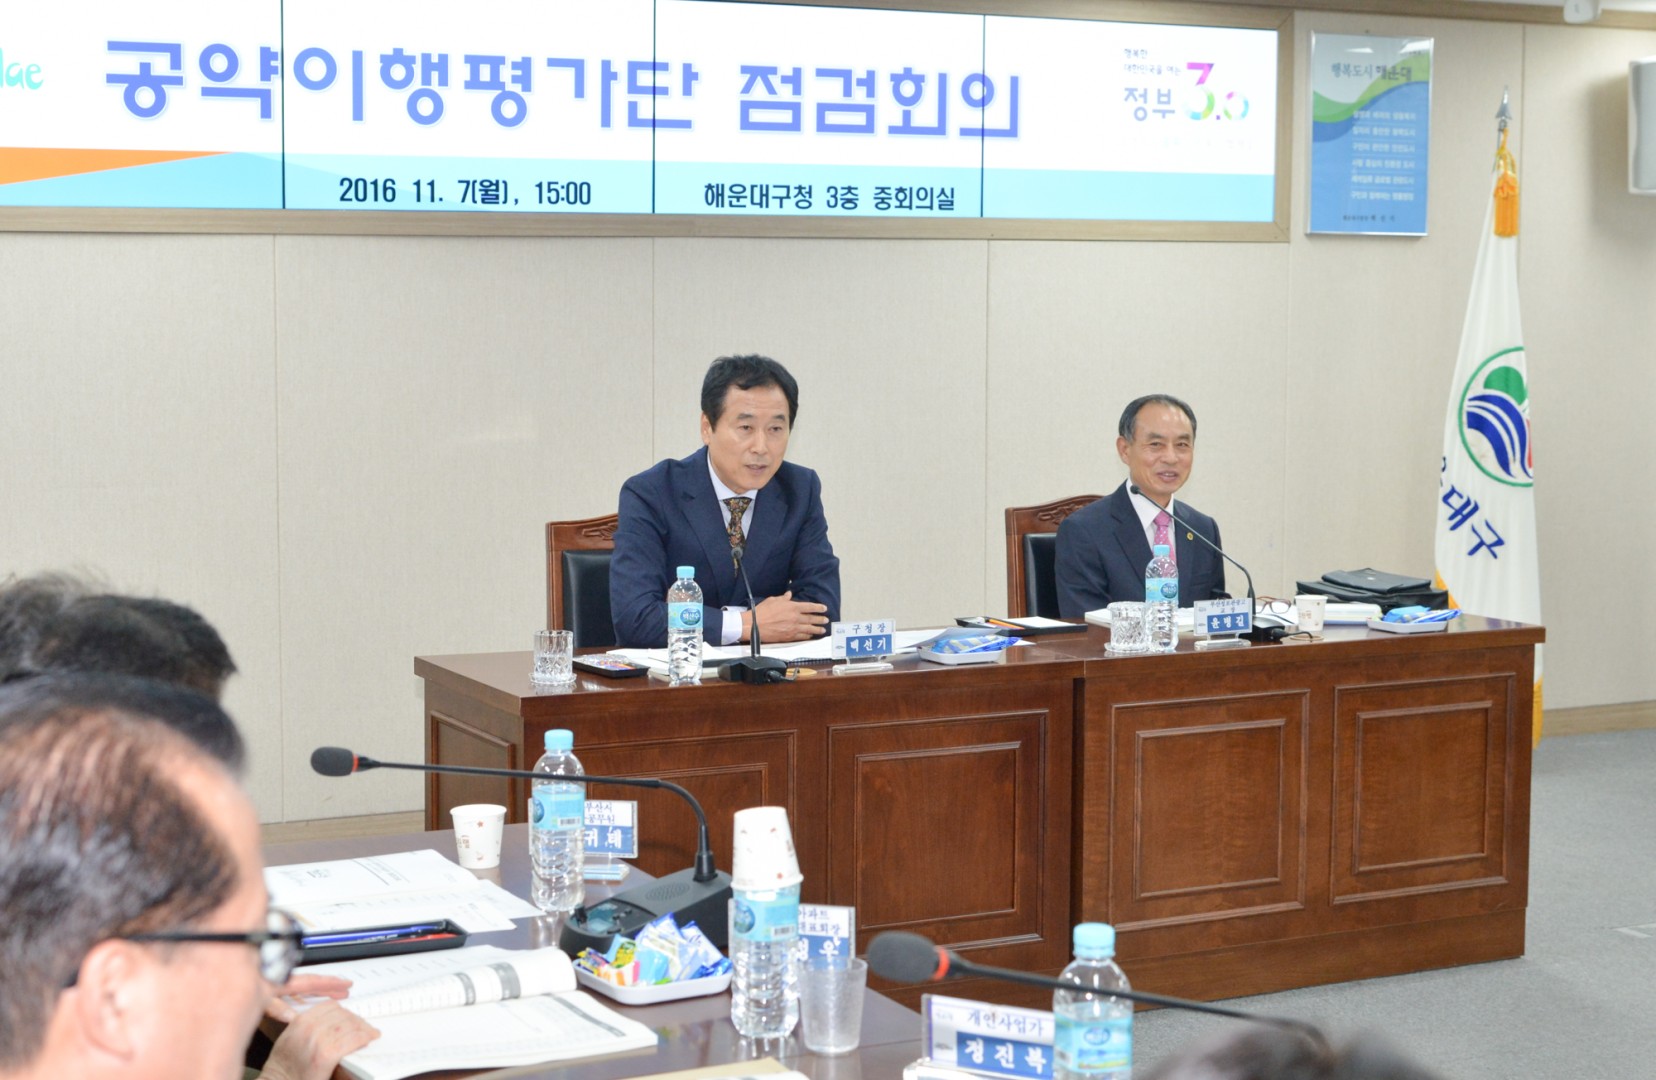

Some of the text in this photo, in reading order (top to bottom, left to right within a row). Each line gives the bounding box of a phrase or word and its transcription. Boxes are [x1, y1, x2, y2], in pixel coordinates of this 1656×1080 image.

[105, 40, 1020, 139] 공약이행평가단 점검회의
[1124, 87, 1176, 122] 정부
[339, 178, 397, 203] 2016
[412, 179, 444, 203] 11.
[534, 180, 593, 206] 15:00
[703, 182, 956, 211] 해운대구청 3층 중회의실
